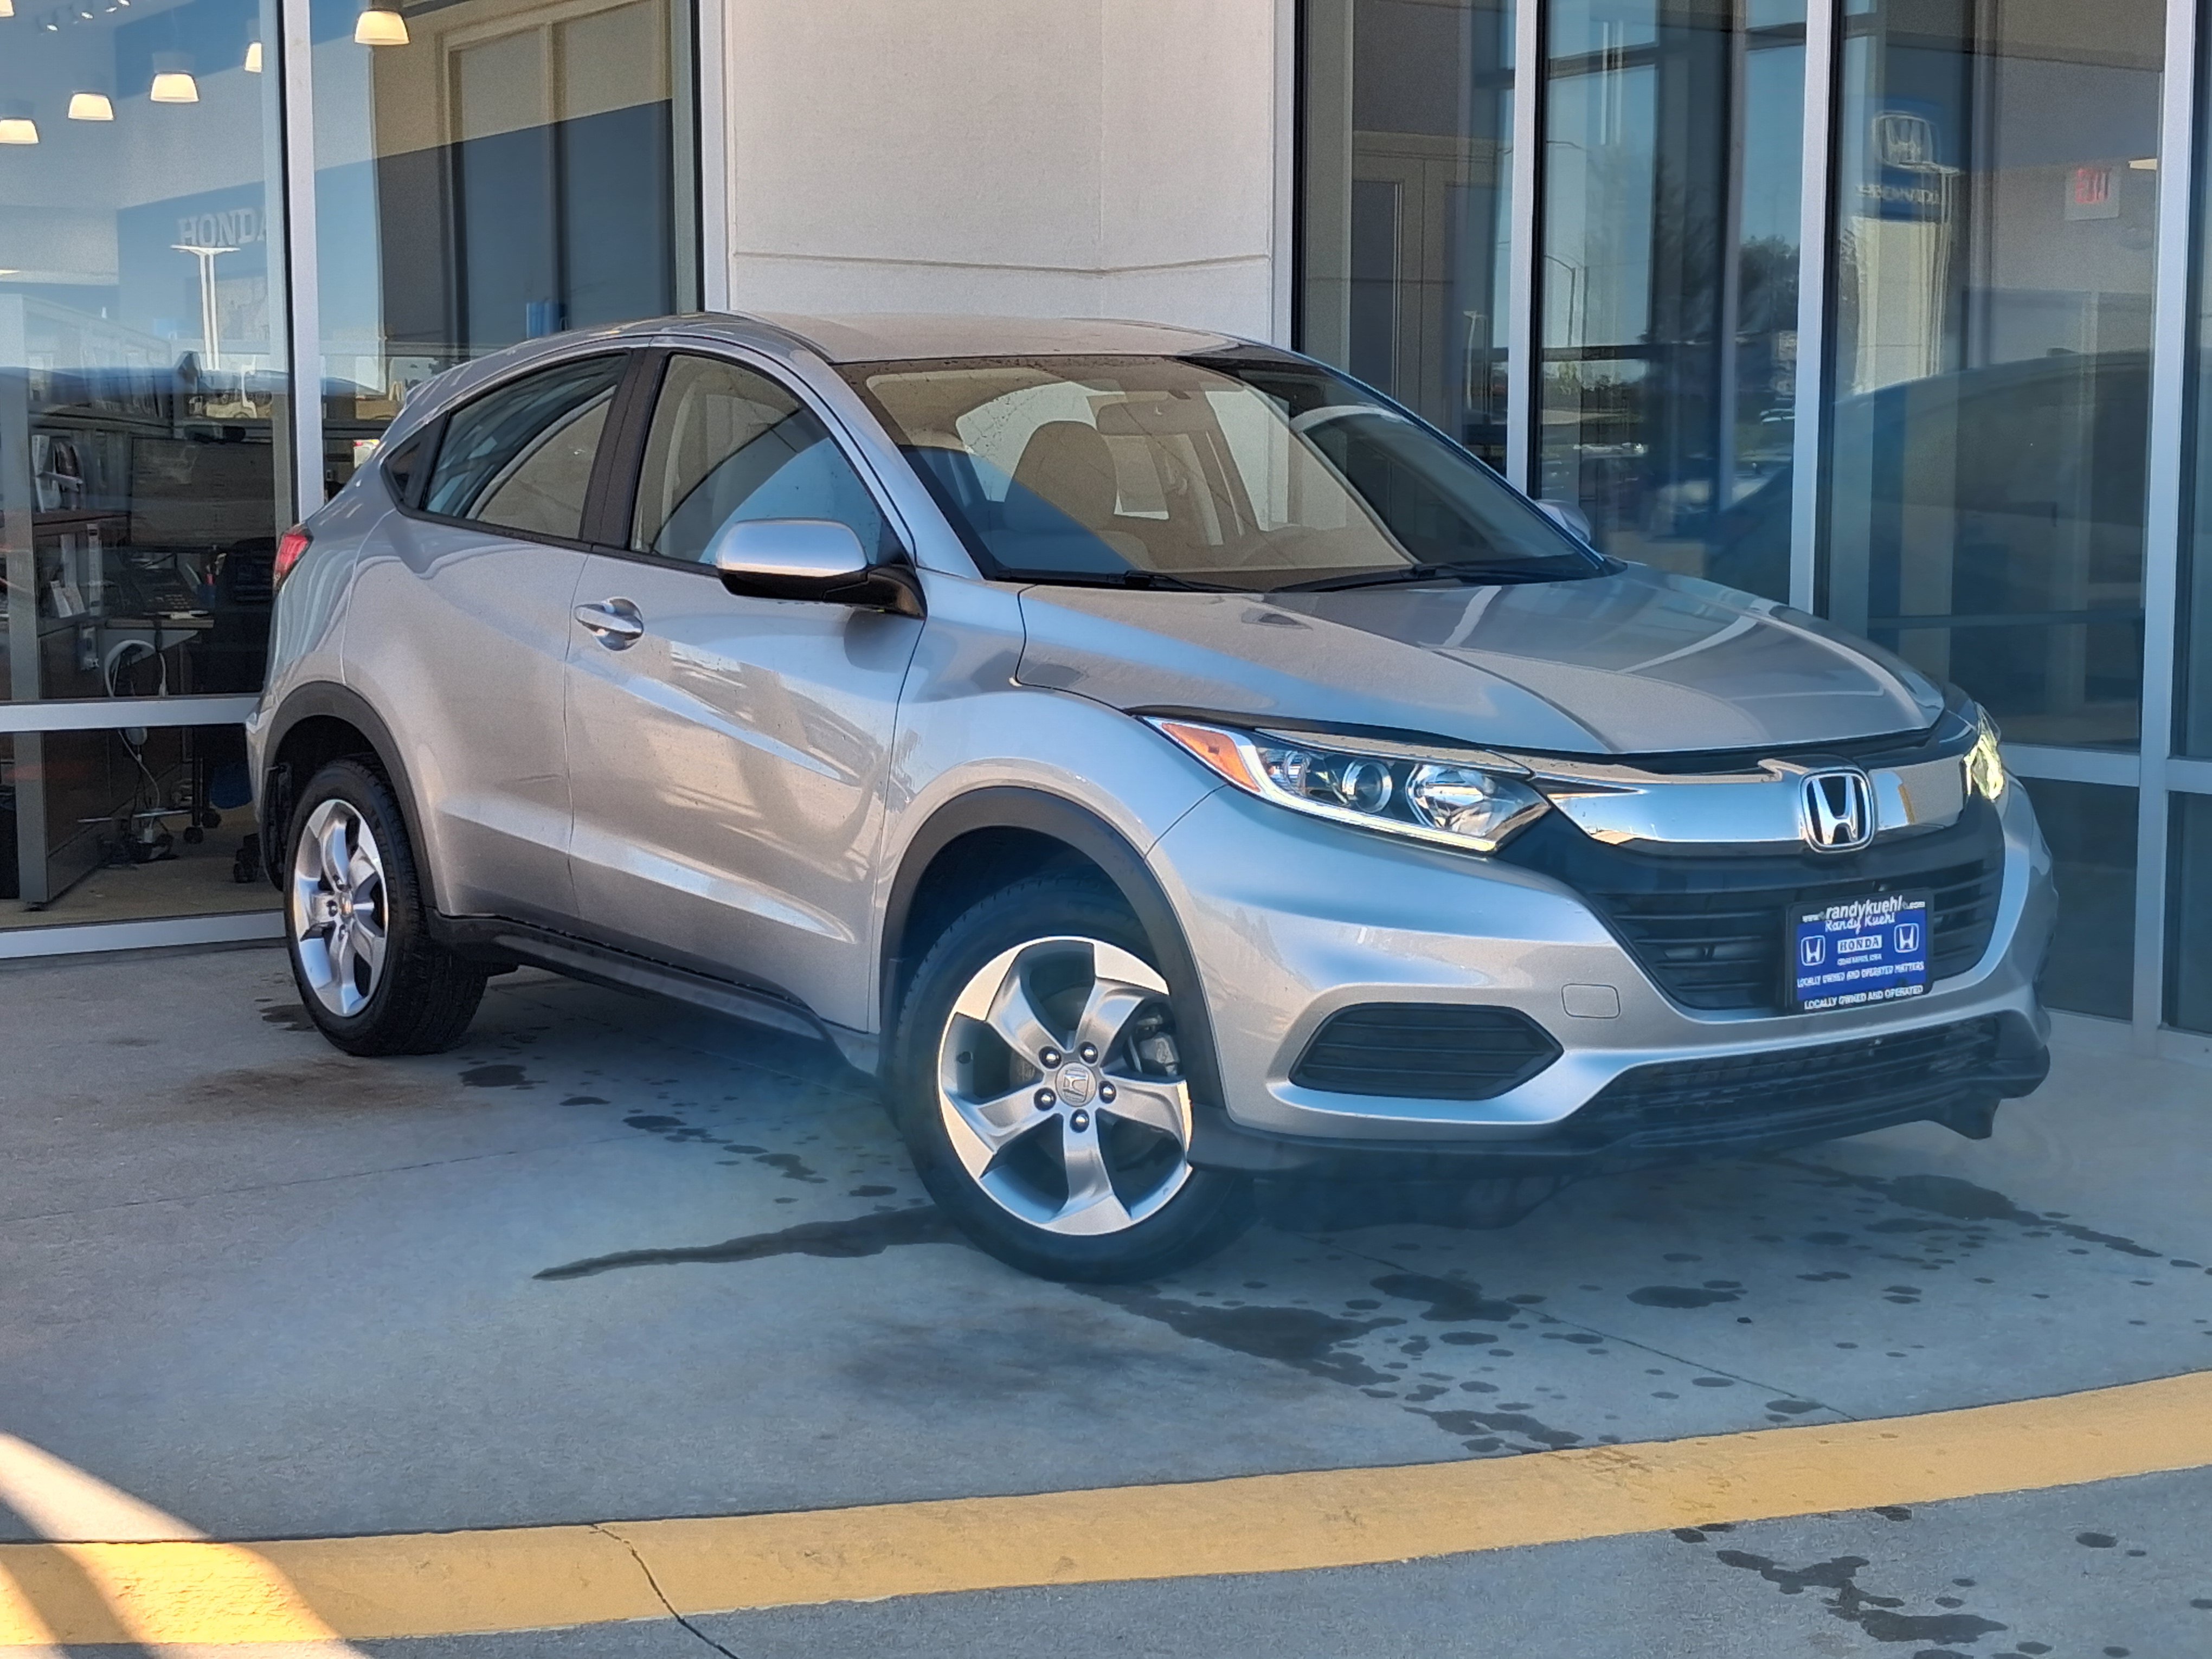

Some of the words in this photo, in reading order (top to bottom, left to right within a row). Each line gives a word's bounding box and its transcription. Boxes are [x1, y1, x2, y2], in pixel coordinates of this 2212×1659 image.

[1825, 917, 1861, 935] Randy
[1864, 912, 1895, 927] Kuehl
[1840, 937, 1879, 951] HONDA
[1804, 997, 1837, 1010] LOCALLY
[1838, 993, 1866, 1005] OWNED
[1868, 991, 1883, 1001] AND
[1885, 985, 1924, 998] OPERATED
